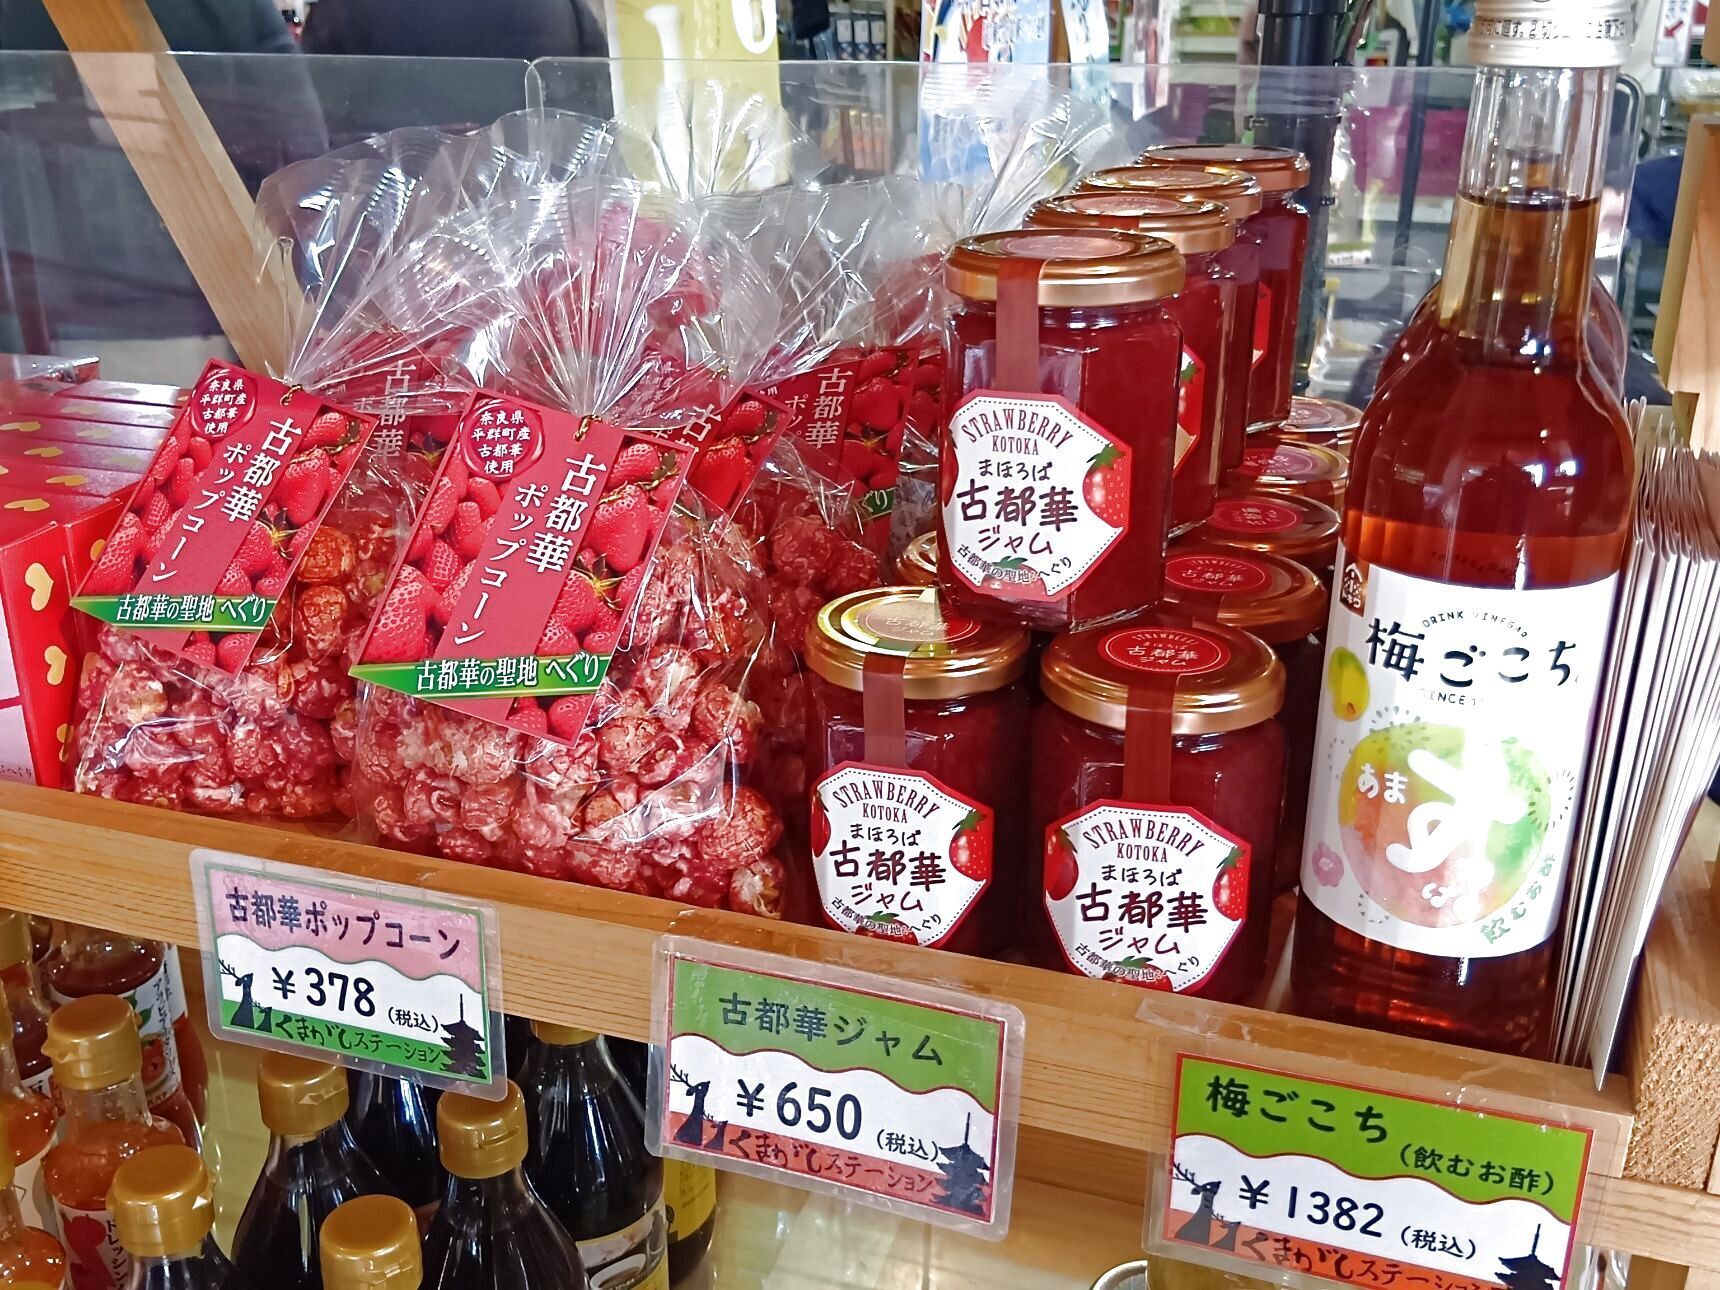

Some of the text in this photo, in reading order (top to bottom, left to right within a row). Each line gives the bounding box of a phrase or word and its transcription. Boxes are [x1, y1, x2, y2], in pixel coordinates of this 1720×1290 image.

[199, 392, 248, 406] 平群町産
[208, 378, 245, 392] 奈良県
[202, 407, 239, 421] 古都華
[479, 410, 525, 424] 奈良県
[805, 367, 853, 449] 古都華
[204, 421, 229, 434] 使用
[471, 426, 532, 441] 平群町産
[961, 408, 1074, 449] STRAWBERRY
[477, 443, 523, 457] 古都華
[992, 435, 1039, 456] KOTOKA
[220, 416, 302, 522] 古都華
[483, 460, 514, 474] 使用
[978, 459, 1053, 481] まほろば
[152, 442, 250, 583] ポップコーン
[525, 453, 607, 573] 古都華
[956, 478, 1079, 532] 古都華
[978, 525, 1054, 555] ジャム
[454, 482, 549, 646] ポップコーン
[116, 594, 267, 623] 古都華の聖地 へぐり
[1365, 616, 1577, 688] 梅ごこち
[416, 653, 600, 692] 古都華の聖地 へぐり
[832, 780, 940, 819] STRAWBERRY
[862, 802, 908, 824] KOTOKA
[850, 823, 922, 847] まほろば
[1082, 818, 1204, 858] STRAWBERRY
[1116, 842, 1168, 863] KOTOKA
[829, 839, 947, 892] 古都華
[1101, 864, 1182, 887] まほろば
[851, 882, 923, 911] ジャム
[1075, 882, 1208, 934] 古都華
[225, 886, 461, 960] 古都華ポップコーン
[1098, 926, 1181, 954] ジャム
[271, 966, 376, 1017] ¥378
[387, 1006, 439, 1033] (税込)
[718, 992, 943, 1066] 古都華ジャム
[736, 1079, 863, 1141] ¥650
[1205, 1075, 1388, 1143] 梅ごこち
[876, 1129, 940, 1162] (税込)
[1400, 1143, 1555, 1196] (飲むお酢)
[105, 1219, 130, 1290] ドレッシン
[1400, 1225, 1476, 1260] (税込)
